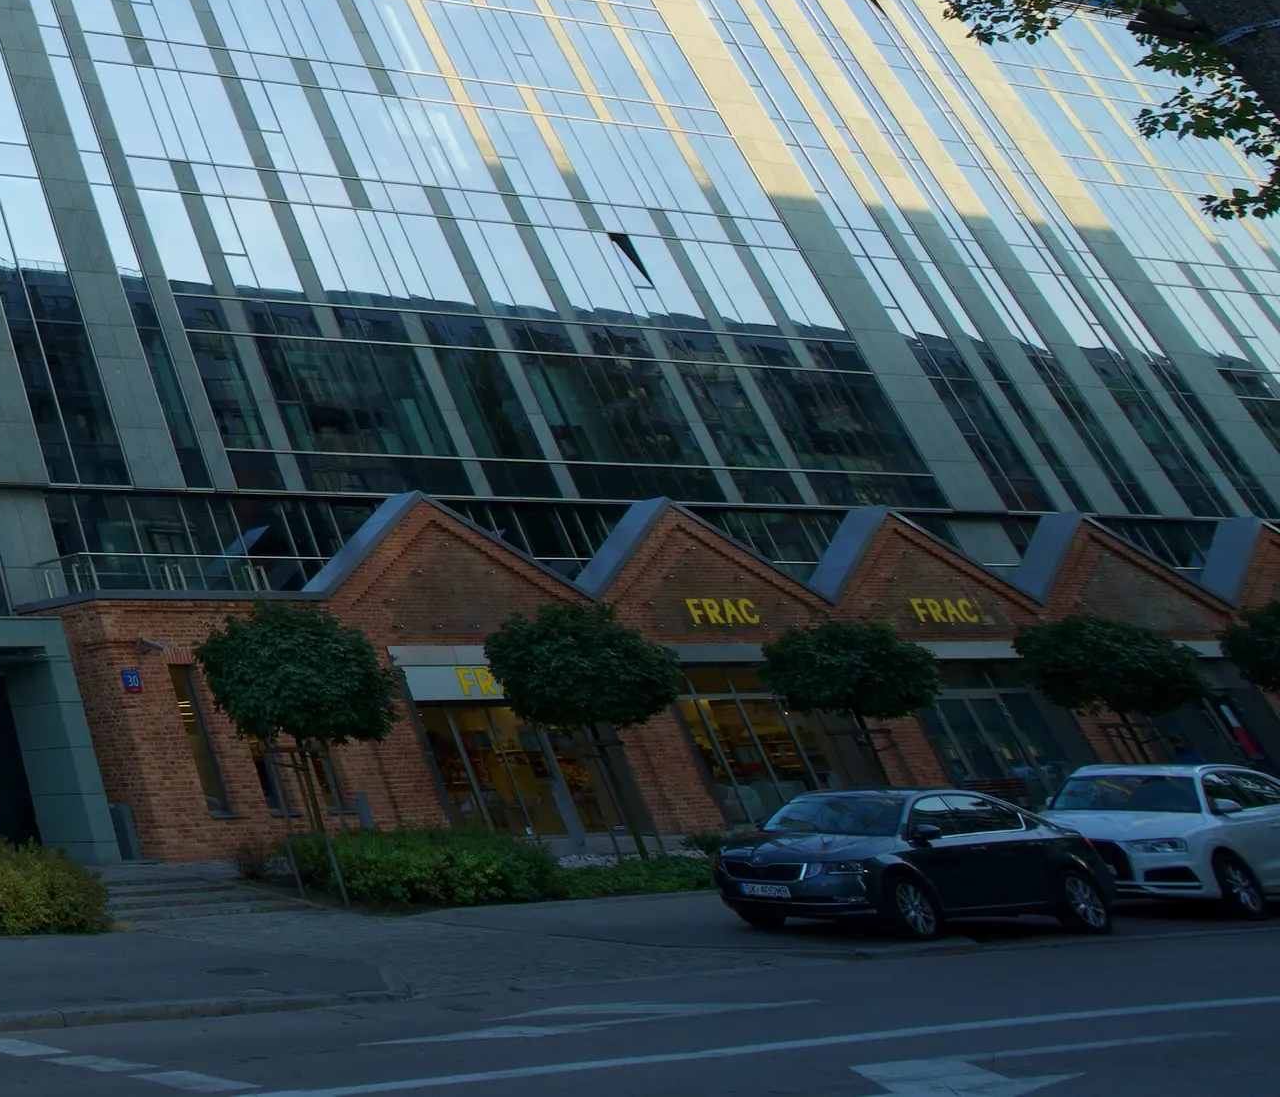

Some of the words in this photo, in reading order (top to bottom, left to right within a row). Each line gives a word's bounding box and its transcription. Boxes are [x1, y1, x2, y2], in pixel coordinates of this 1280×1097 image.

[685, 598, 760, 624] FRAC
[910, 598, 979, 624] FRAC
[127, 675, 140, 687] 30
